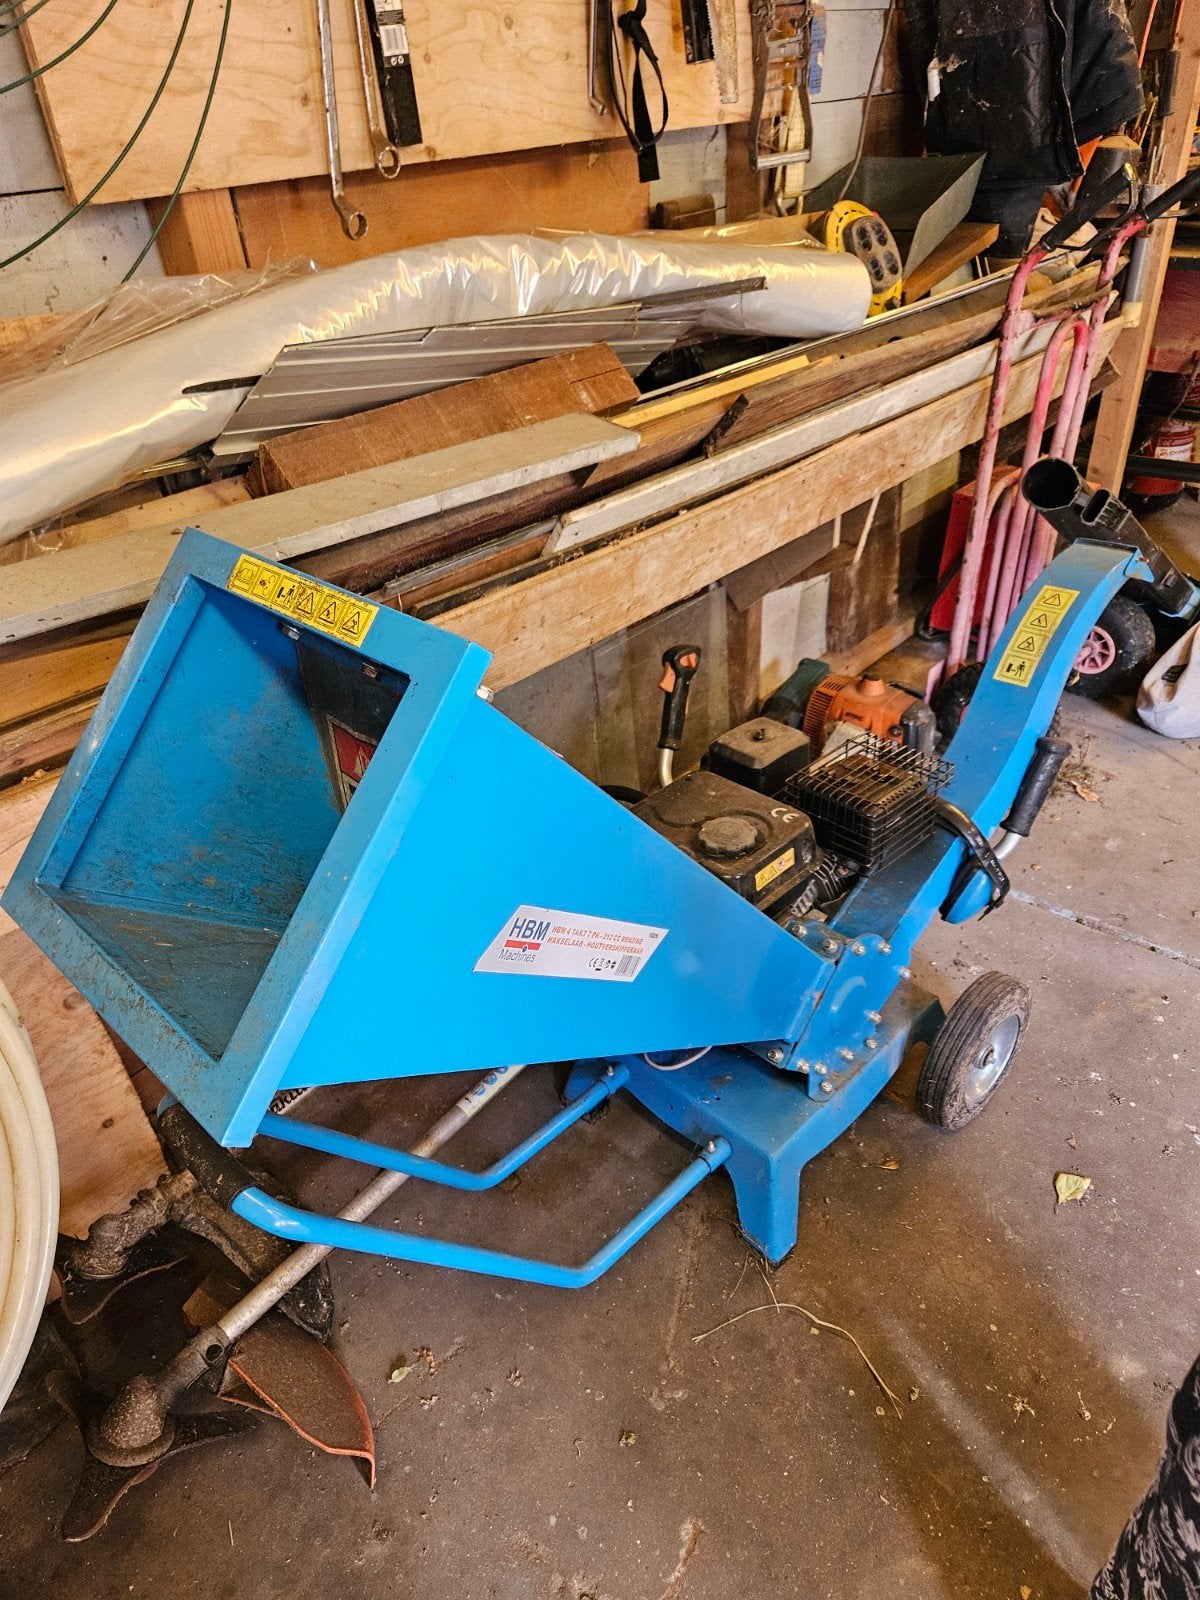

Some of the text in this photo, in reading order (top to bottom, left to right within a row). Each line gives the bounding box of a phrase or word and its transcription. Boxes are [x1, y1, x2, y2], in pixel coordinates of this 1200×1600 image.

[845, 711, 864, 721] STIHL
[771, 807, 800, 823] CE
[509, 917, 551, 941] HBM
[551, 926, 567, 934] HBM
[572, 928, 587, 937] TAKT
[592, 931, 600, 939] PK
[621, 936, 644, 945] BENZINE
[546, 937, 583, 947] HAKSELAAR
[498, 949, 536, 963] Machines
